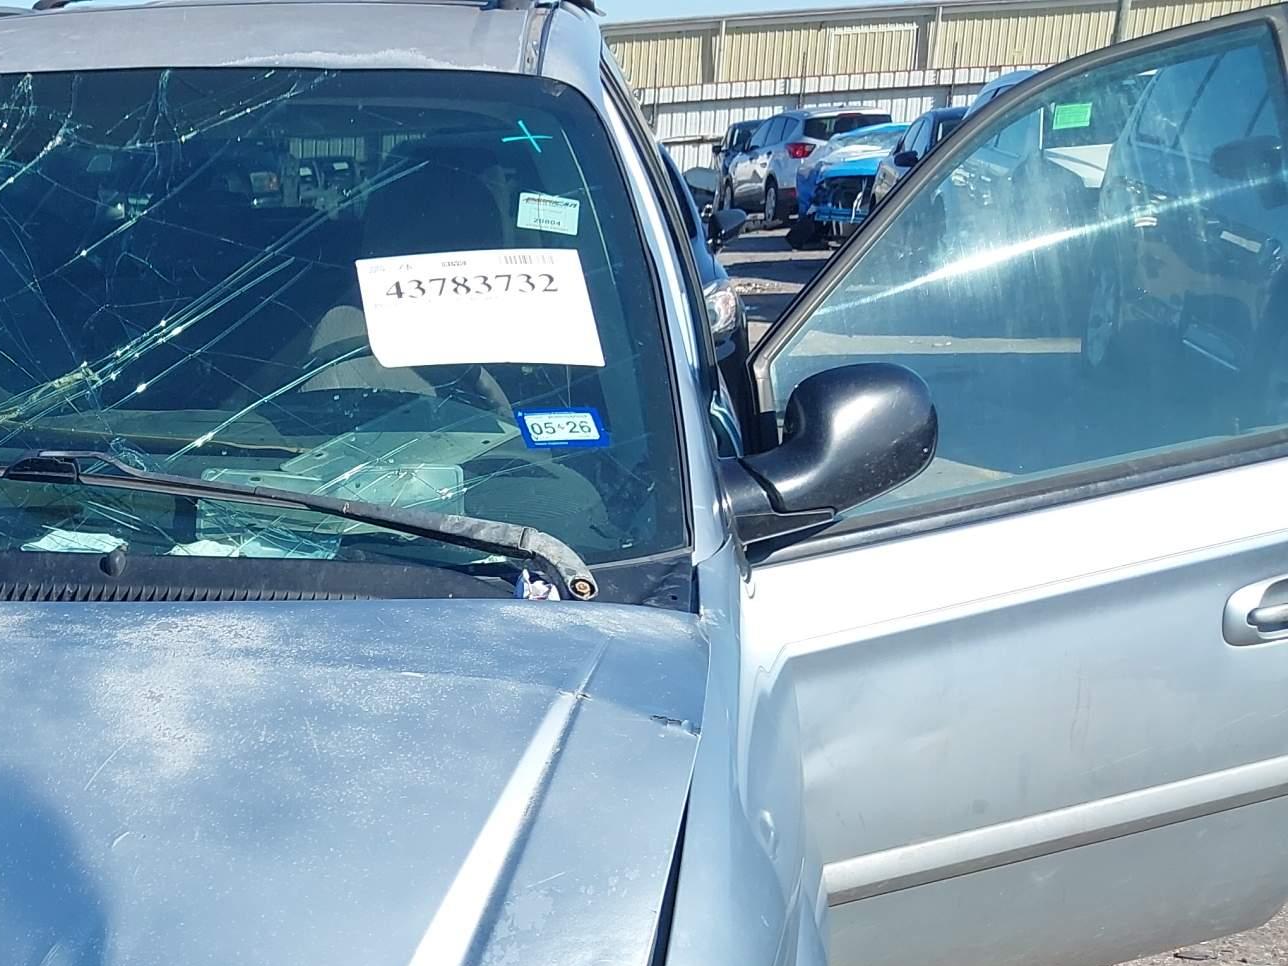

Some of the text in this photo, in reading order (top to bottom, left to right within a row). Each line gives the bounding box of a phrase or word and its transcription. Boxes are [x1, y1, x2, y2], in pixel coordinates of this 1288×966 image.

[385, 273, 559, 299] 43783732
[530, 420, 592, 435] 05 26
